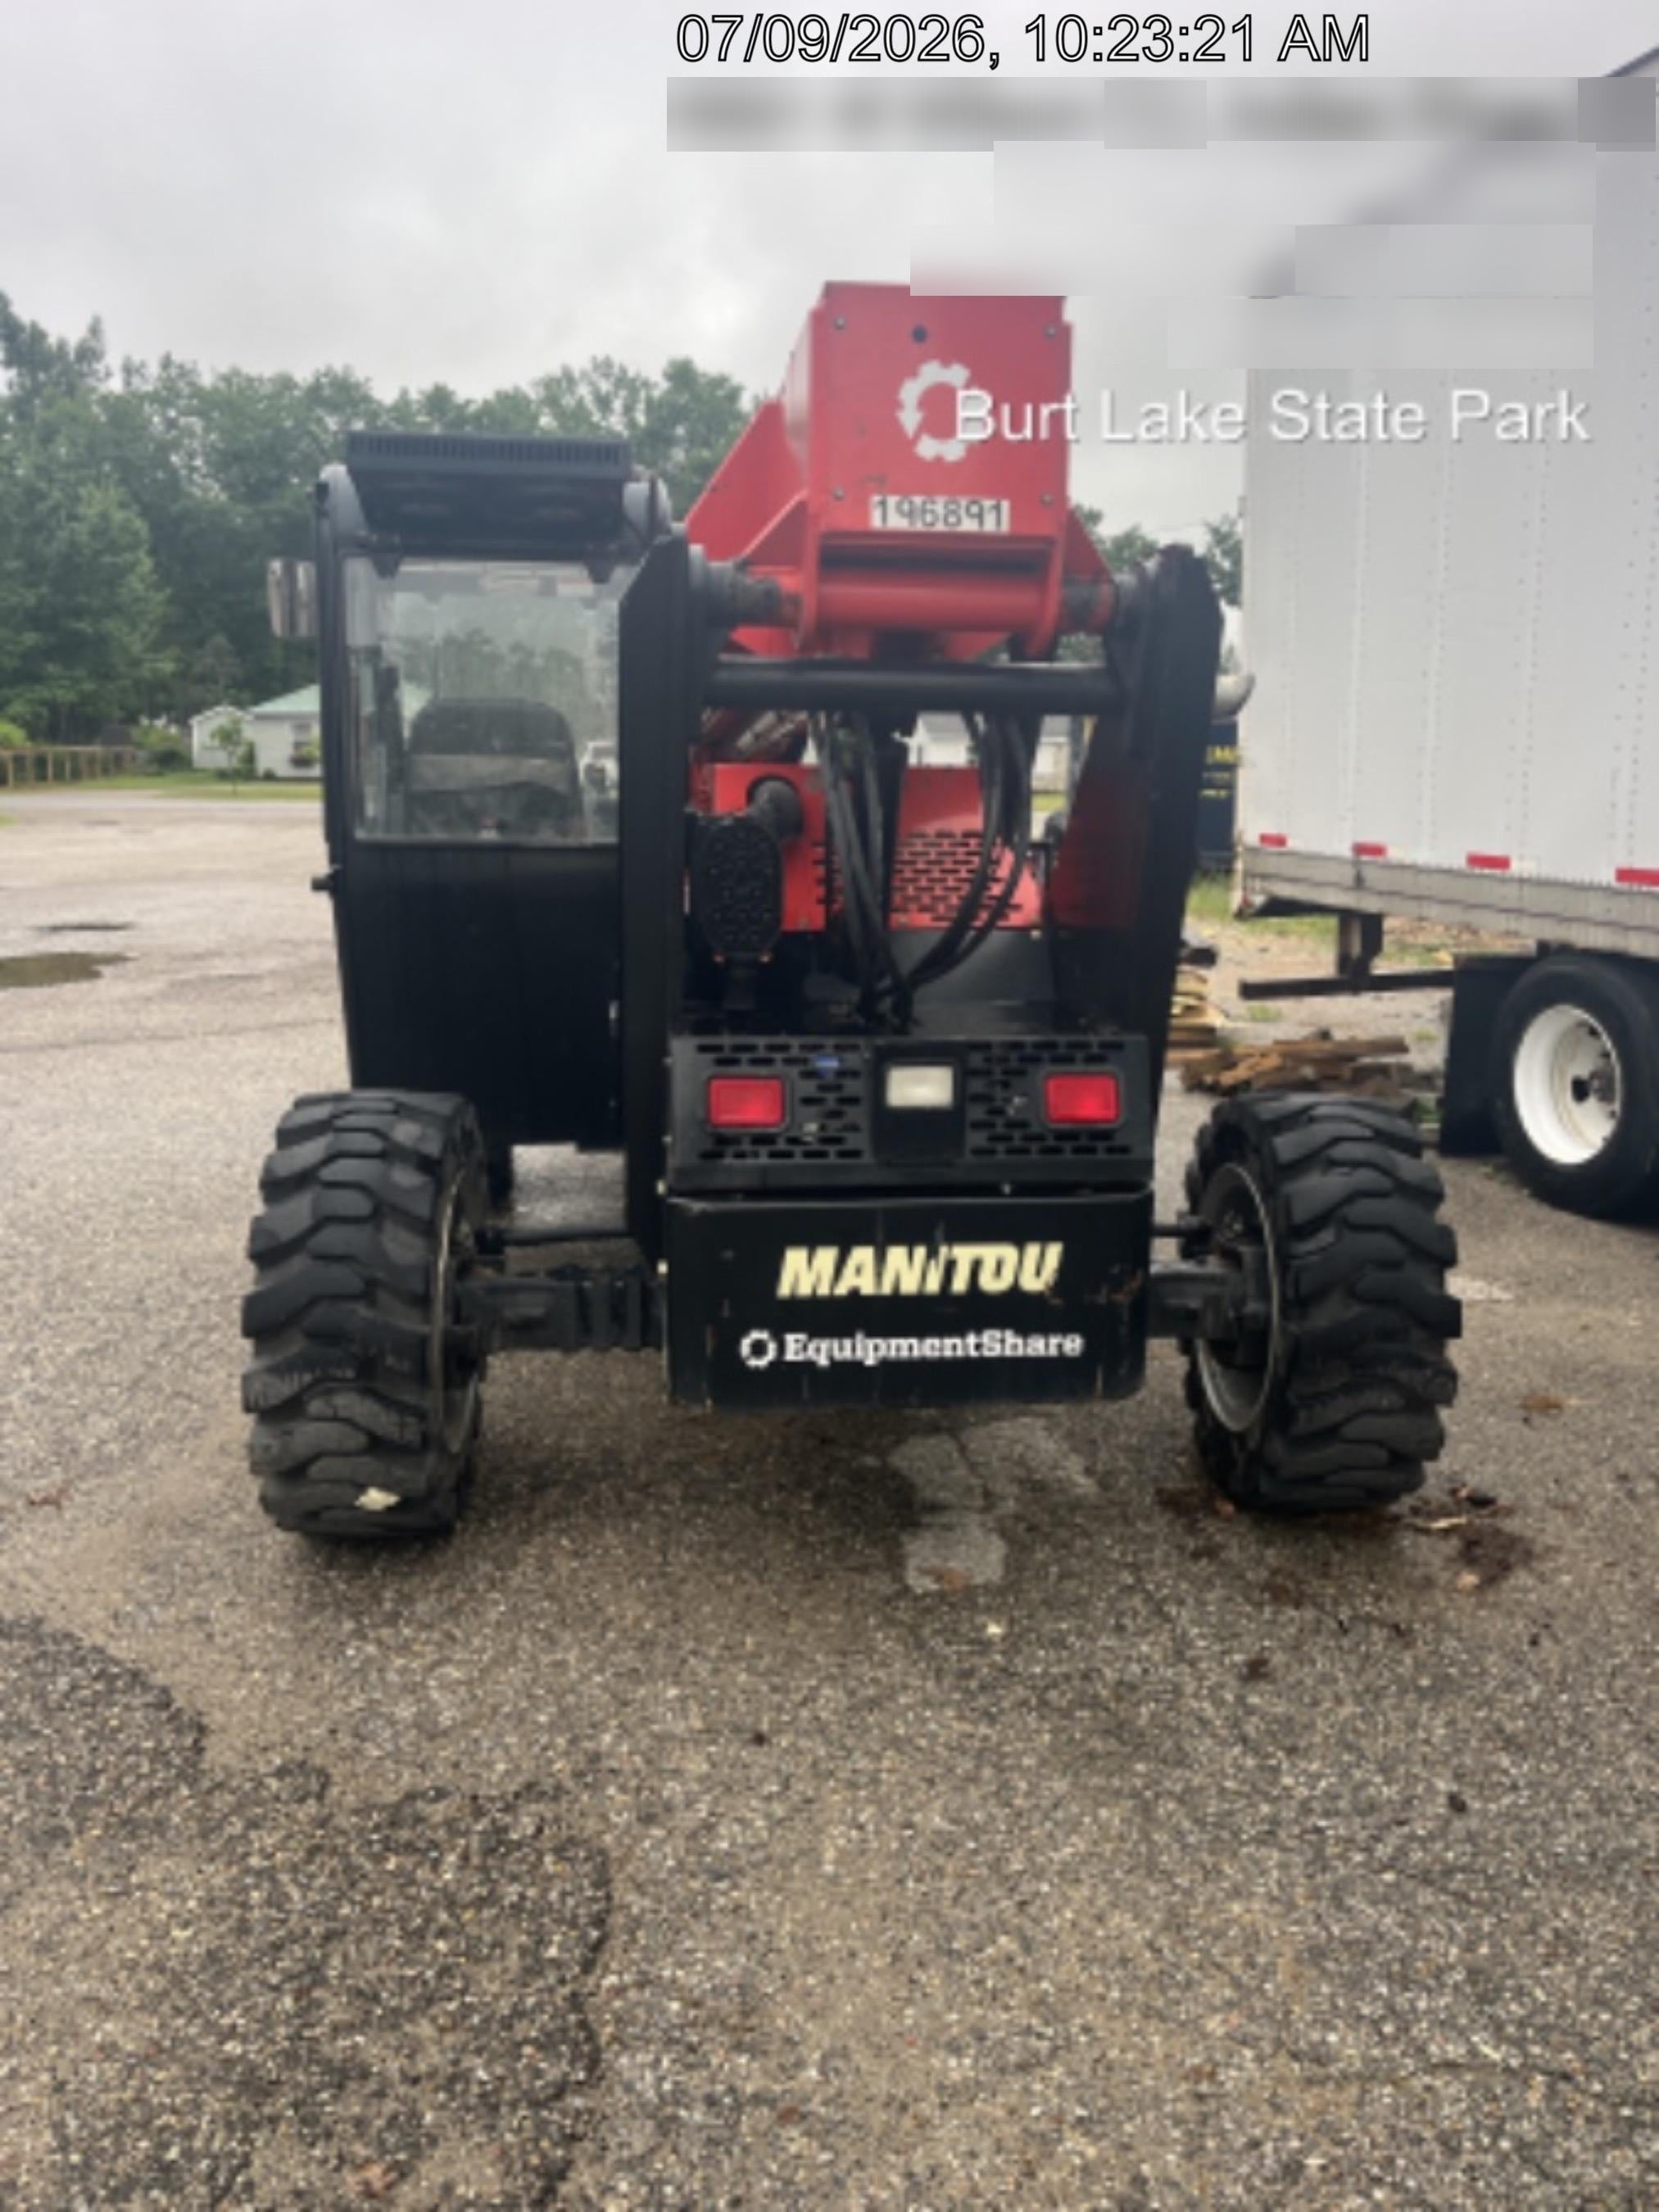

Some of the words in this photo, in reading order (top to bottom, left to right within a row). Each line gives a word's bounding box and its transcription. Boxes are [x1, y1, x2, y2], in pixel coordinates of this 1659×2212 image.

[873, 493, 1003, 530] 196891
[776, 1241, 1063, 1299] MANITOU
[782, 1329, 1086, 1368] EquipmentShare
